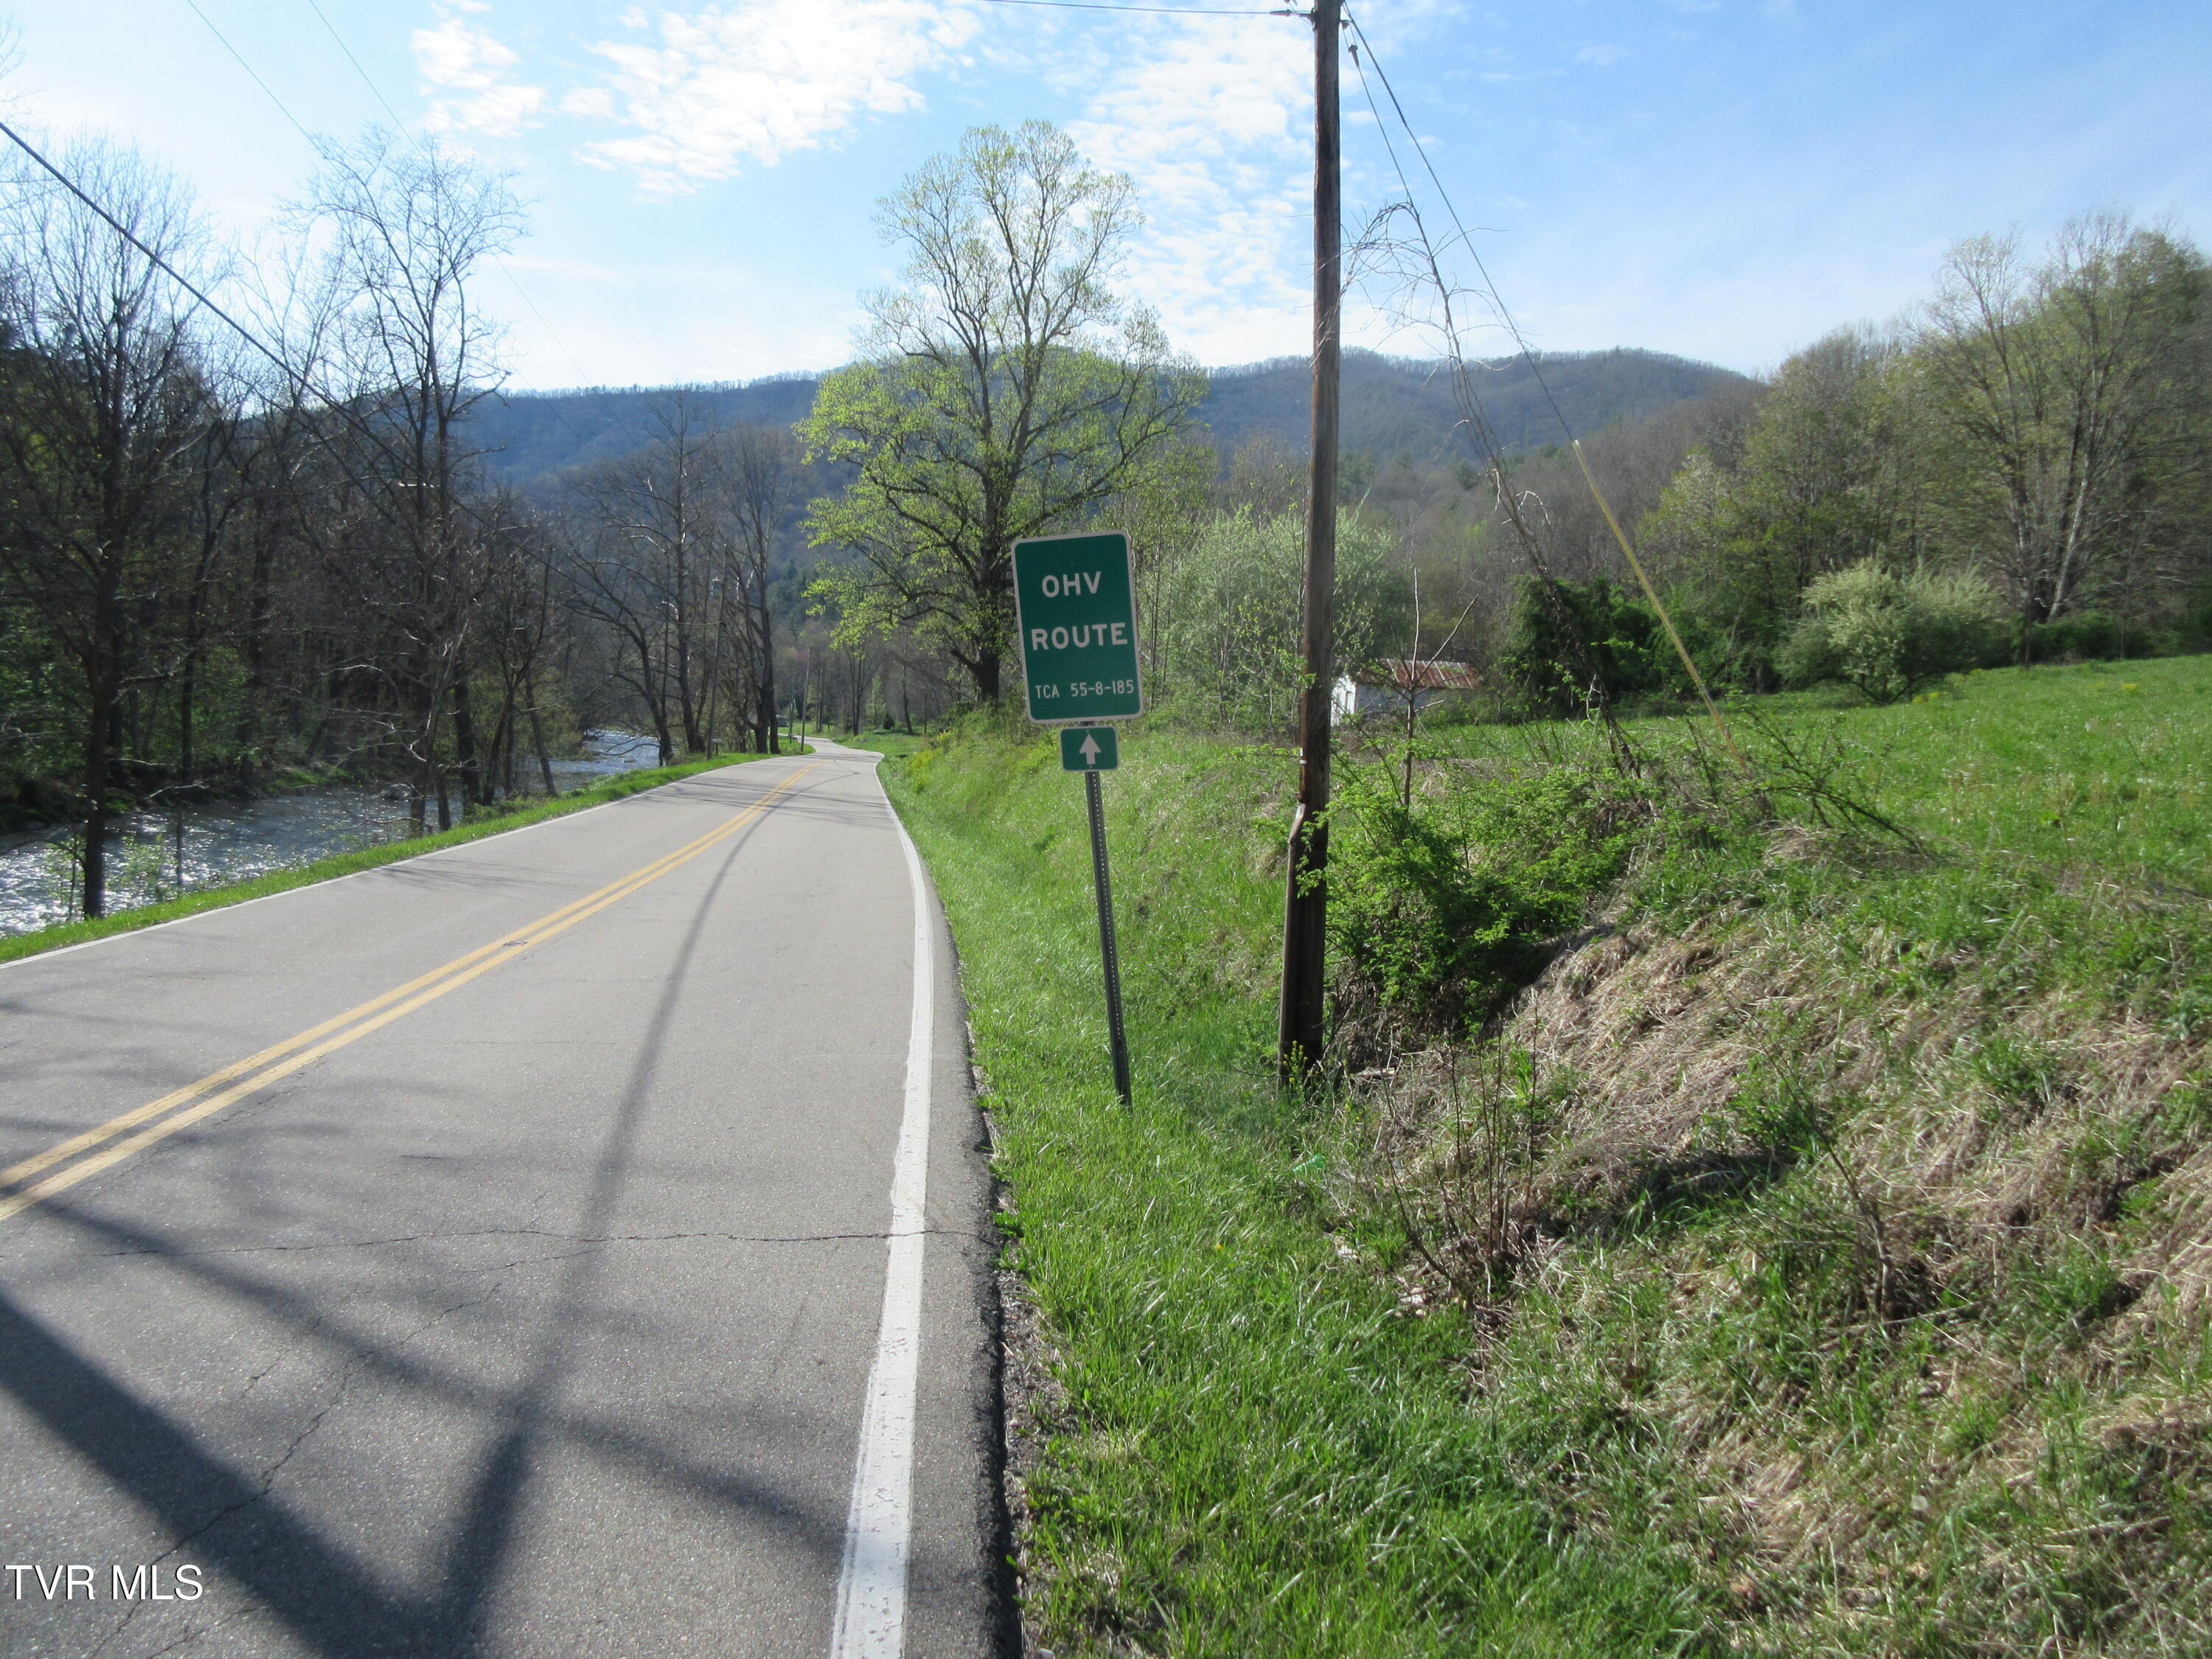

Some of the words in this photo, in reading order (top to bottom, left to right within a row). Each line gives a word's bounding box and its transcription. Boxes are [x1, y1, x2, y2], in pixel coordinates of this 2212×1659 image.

[1042, 571, 1102, 597] OHV
[1032, 622, 1128, 650] ROUTE
[1035, 684, 1060, 699] TCA
[1071, 679, 1134, 697] 55-8-185
